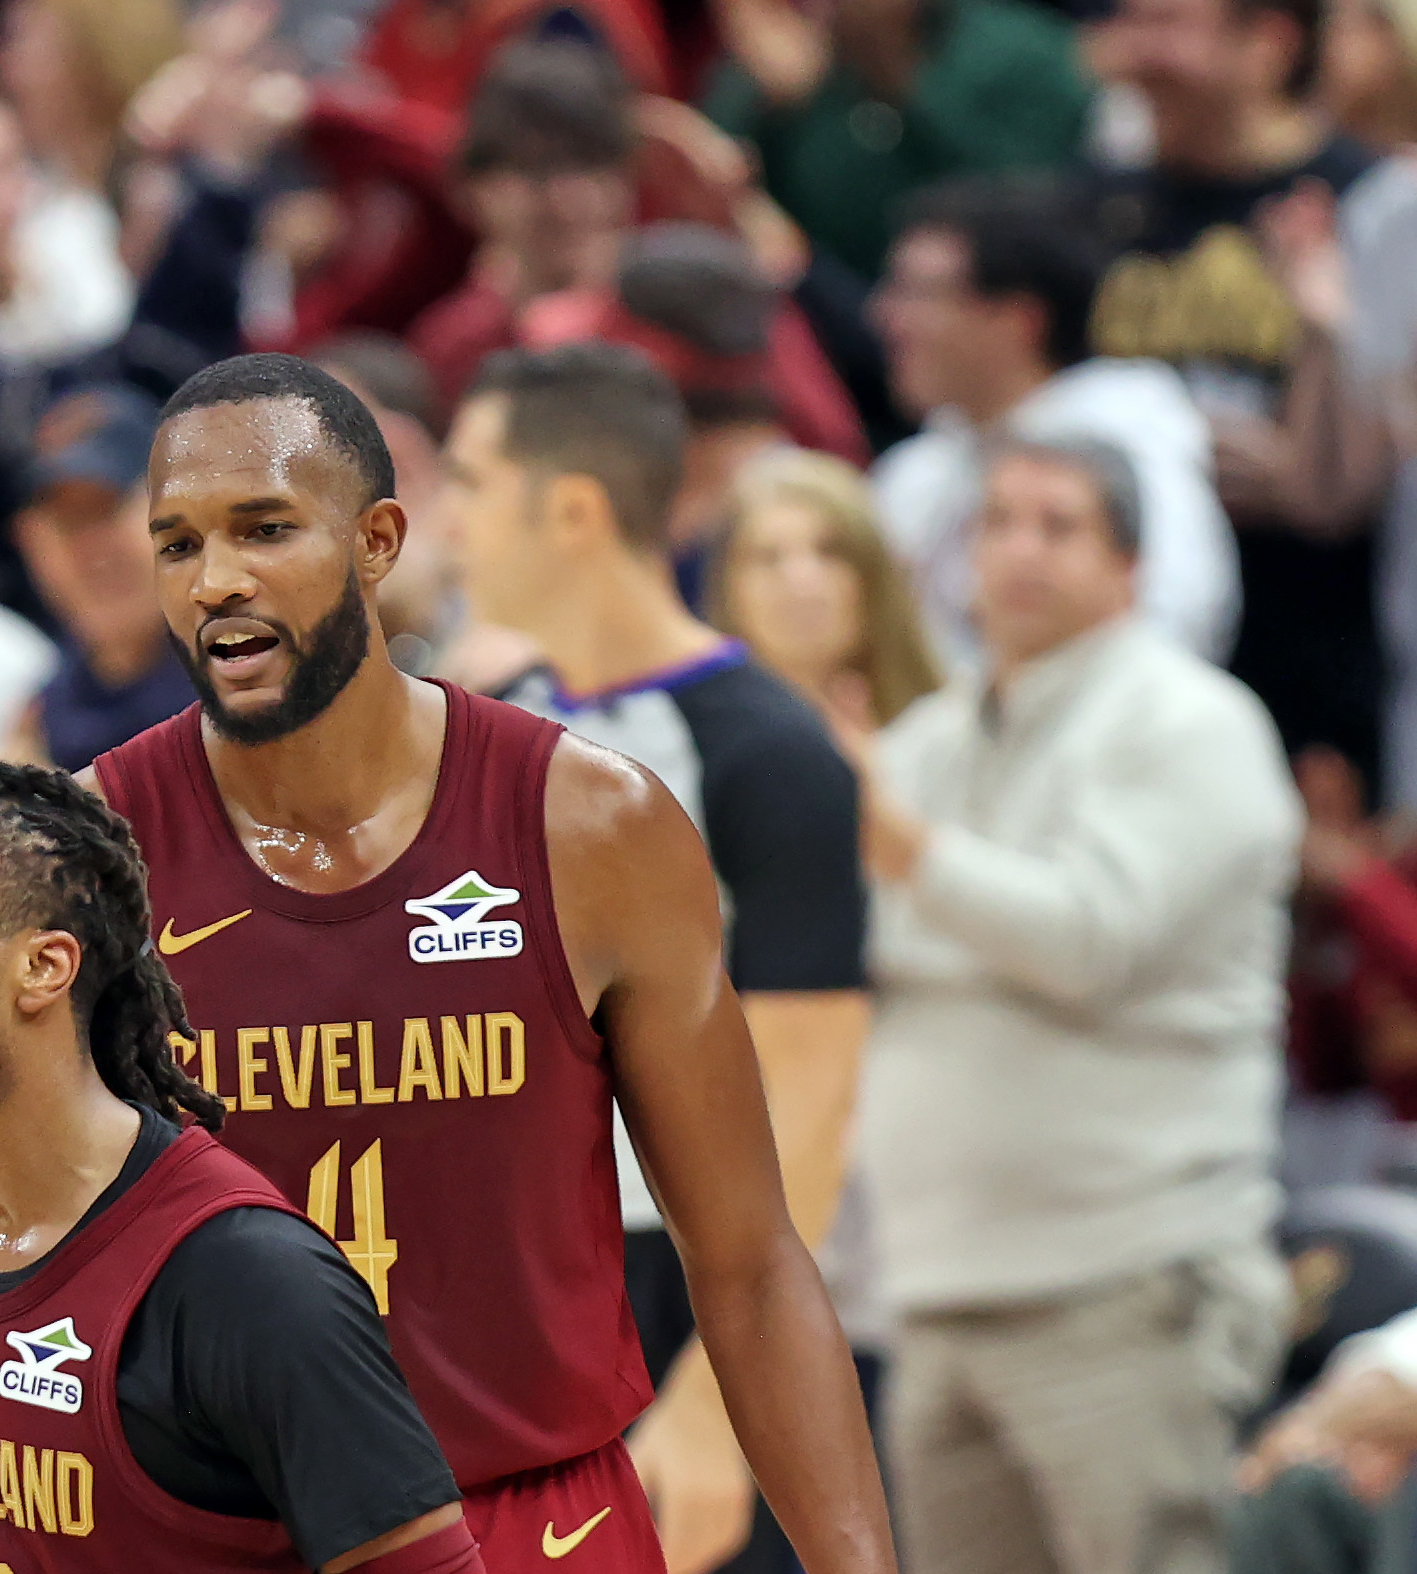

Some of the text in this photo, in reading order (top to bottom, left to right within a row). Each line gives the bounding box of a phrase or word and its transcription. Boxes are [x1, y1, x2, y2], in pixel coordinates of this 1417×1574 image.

[414, 928, 518, 954] CLIFFS
[307, 1137, 398, 1317] 4
[2, 1369, 79, 1406] CLIFFS
